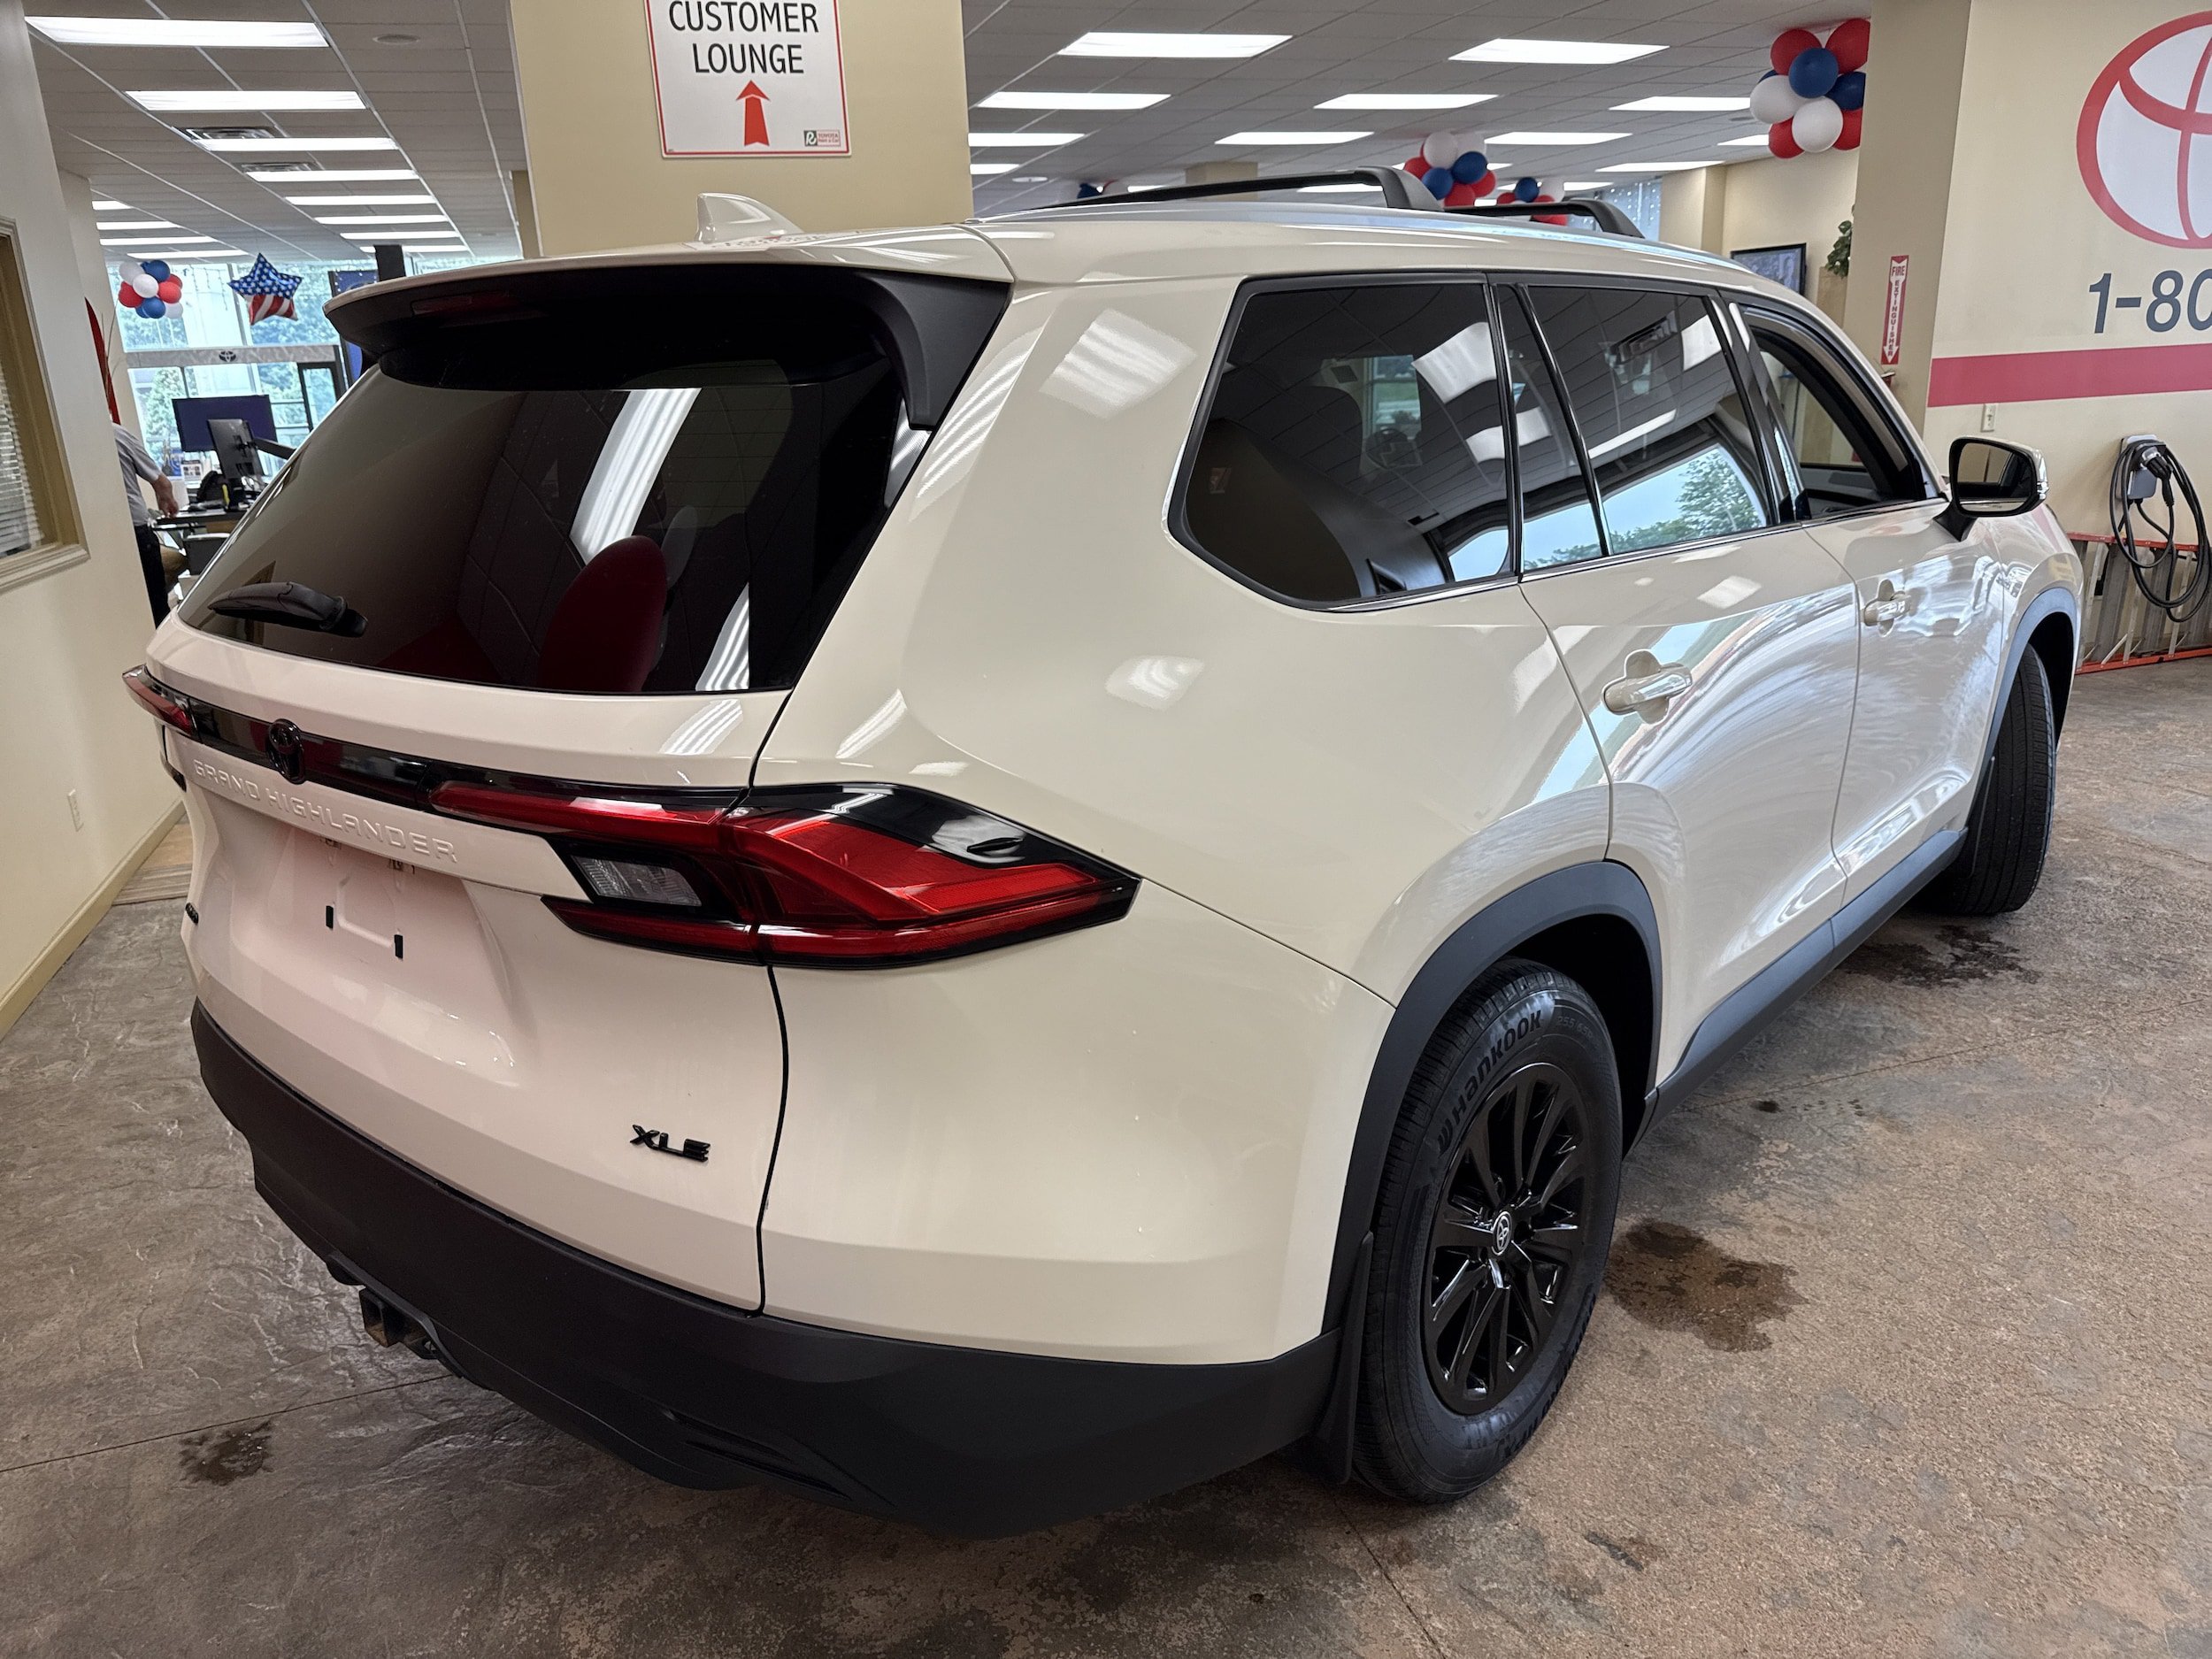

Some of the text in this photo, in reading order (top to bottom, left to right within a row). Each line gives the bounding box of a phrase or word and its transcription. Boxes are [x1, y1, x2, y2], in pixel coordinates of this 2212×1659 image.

[669, 1, 819, 33] CUSTOMER
[693, 43, 804, 73] LOUNGE
[1892, 265, 1905, 276] FIRE
[1887, 280, 1900, 356] EXTINGUISHER
[194, 758, 458, 863] GRAND HIGHLANDER
[630, 1124, 710, 1162] XLE
